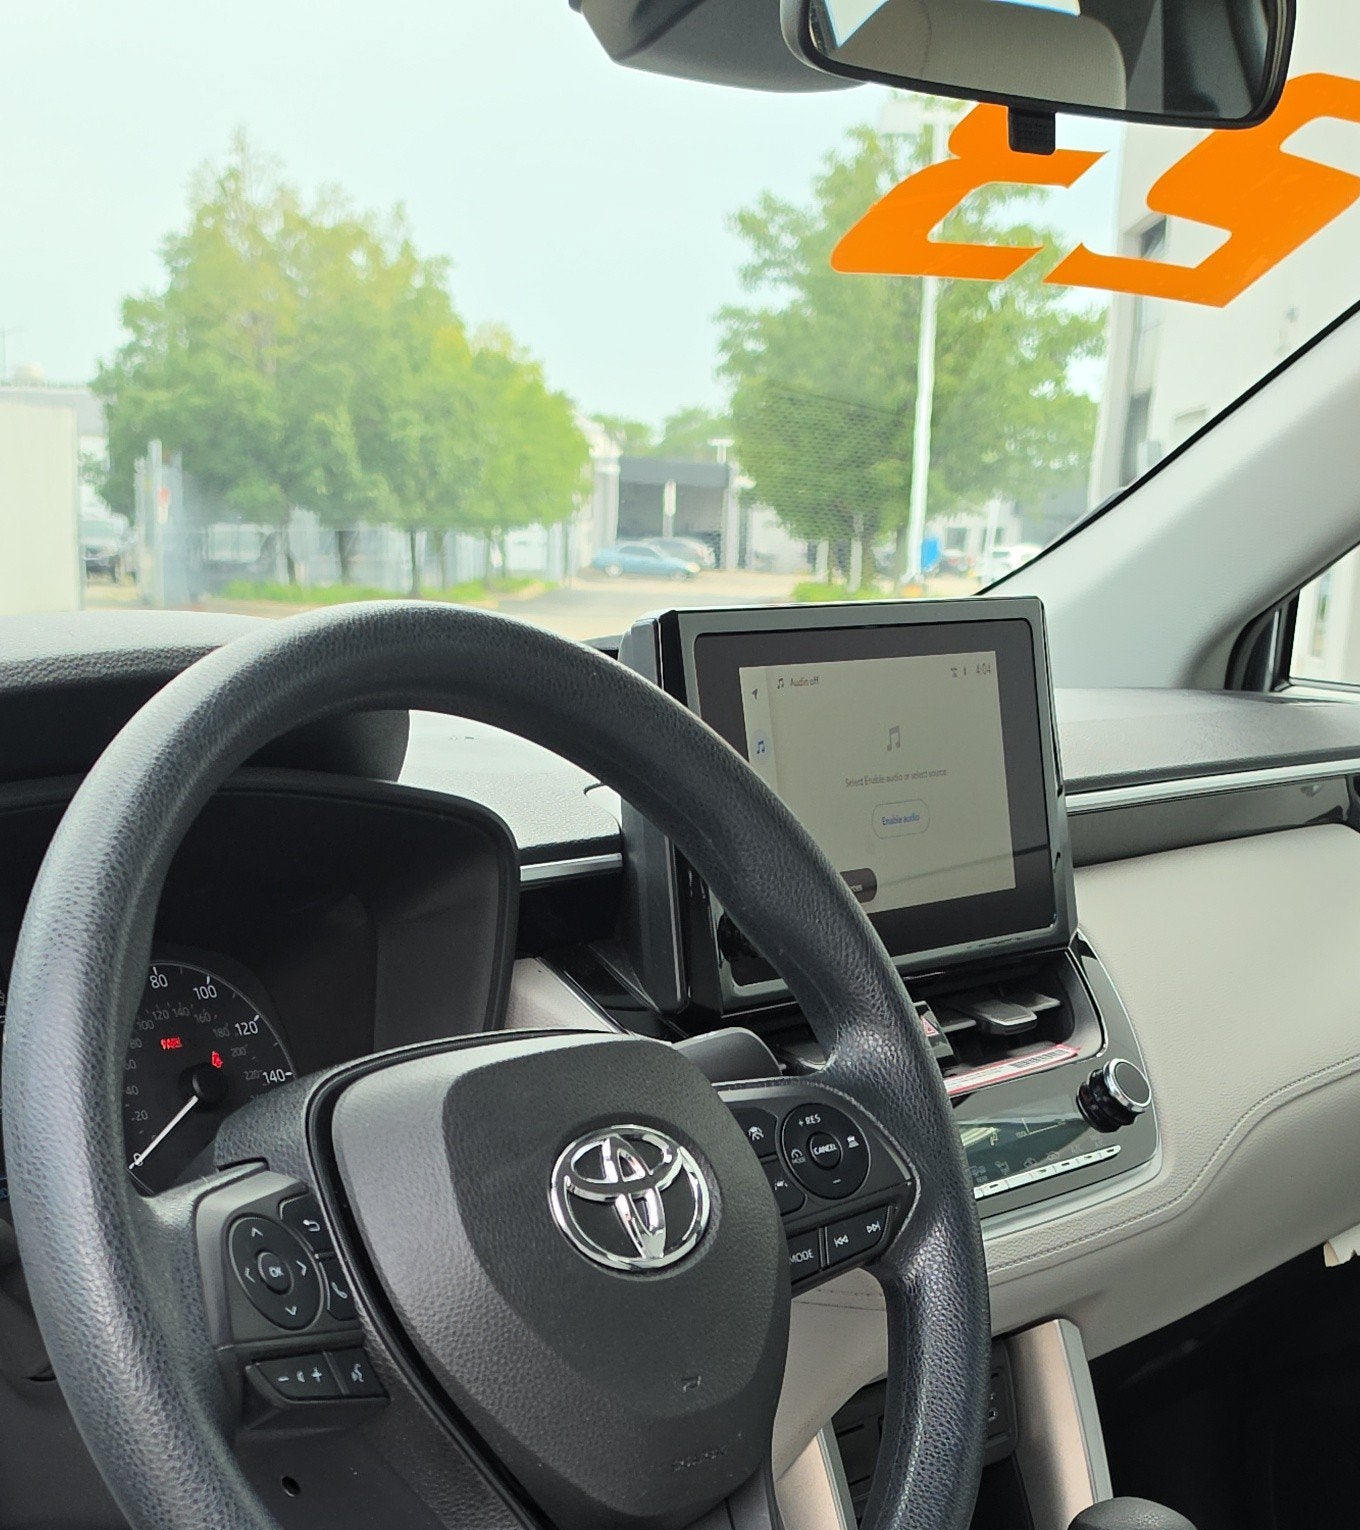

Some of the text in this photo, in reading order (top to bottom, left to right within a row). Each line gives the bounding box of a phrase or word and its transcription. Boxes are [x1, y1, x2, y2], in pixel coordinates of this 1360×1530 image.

[149, 974, 168, 989] 80
[192, 985, 218, 1000] 100
[234, 1020, 259, 1036] 120
[262, 1069, 286, 1084] 140
[805, 1113, 821, 1126] RES
[813, 1143, 838, 1156] CANCEL
